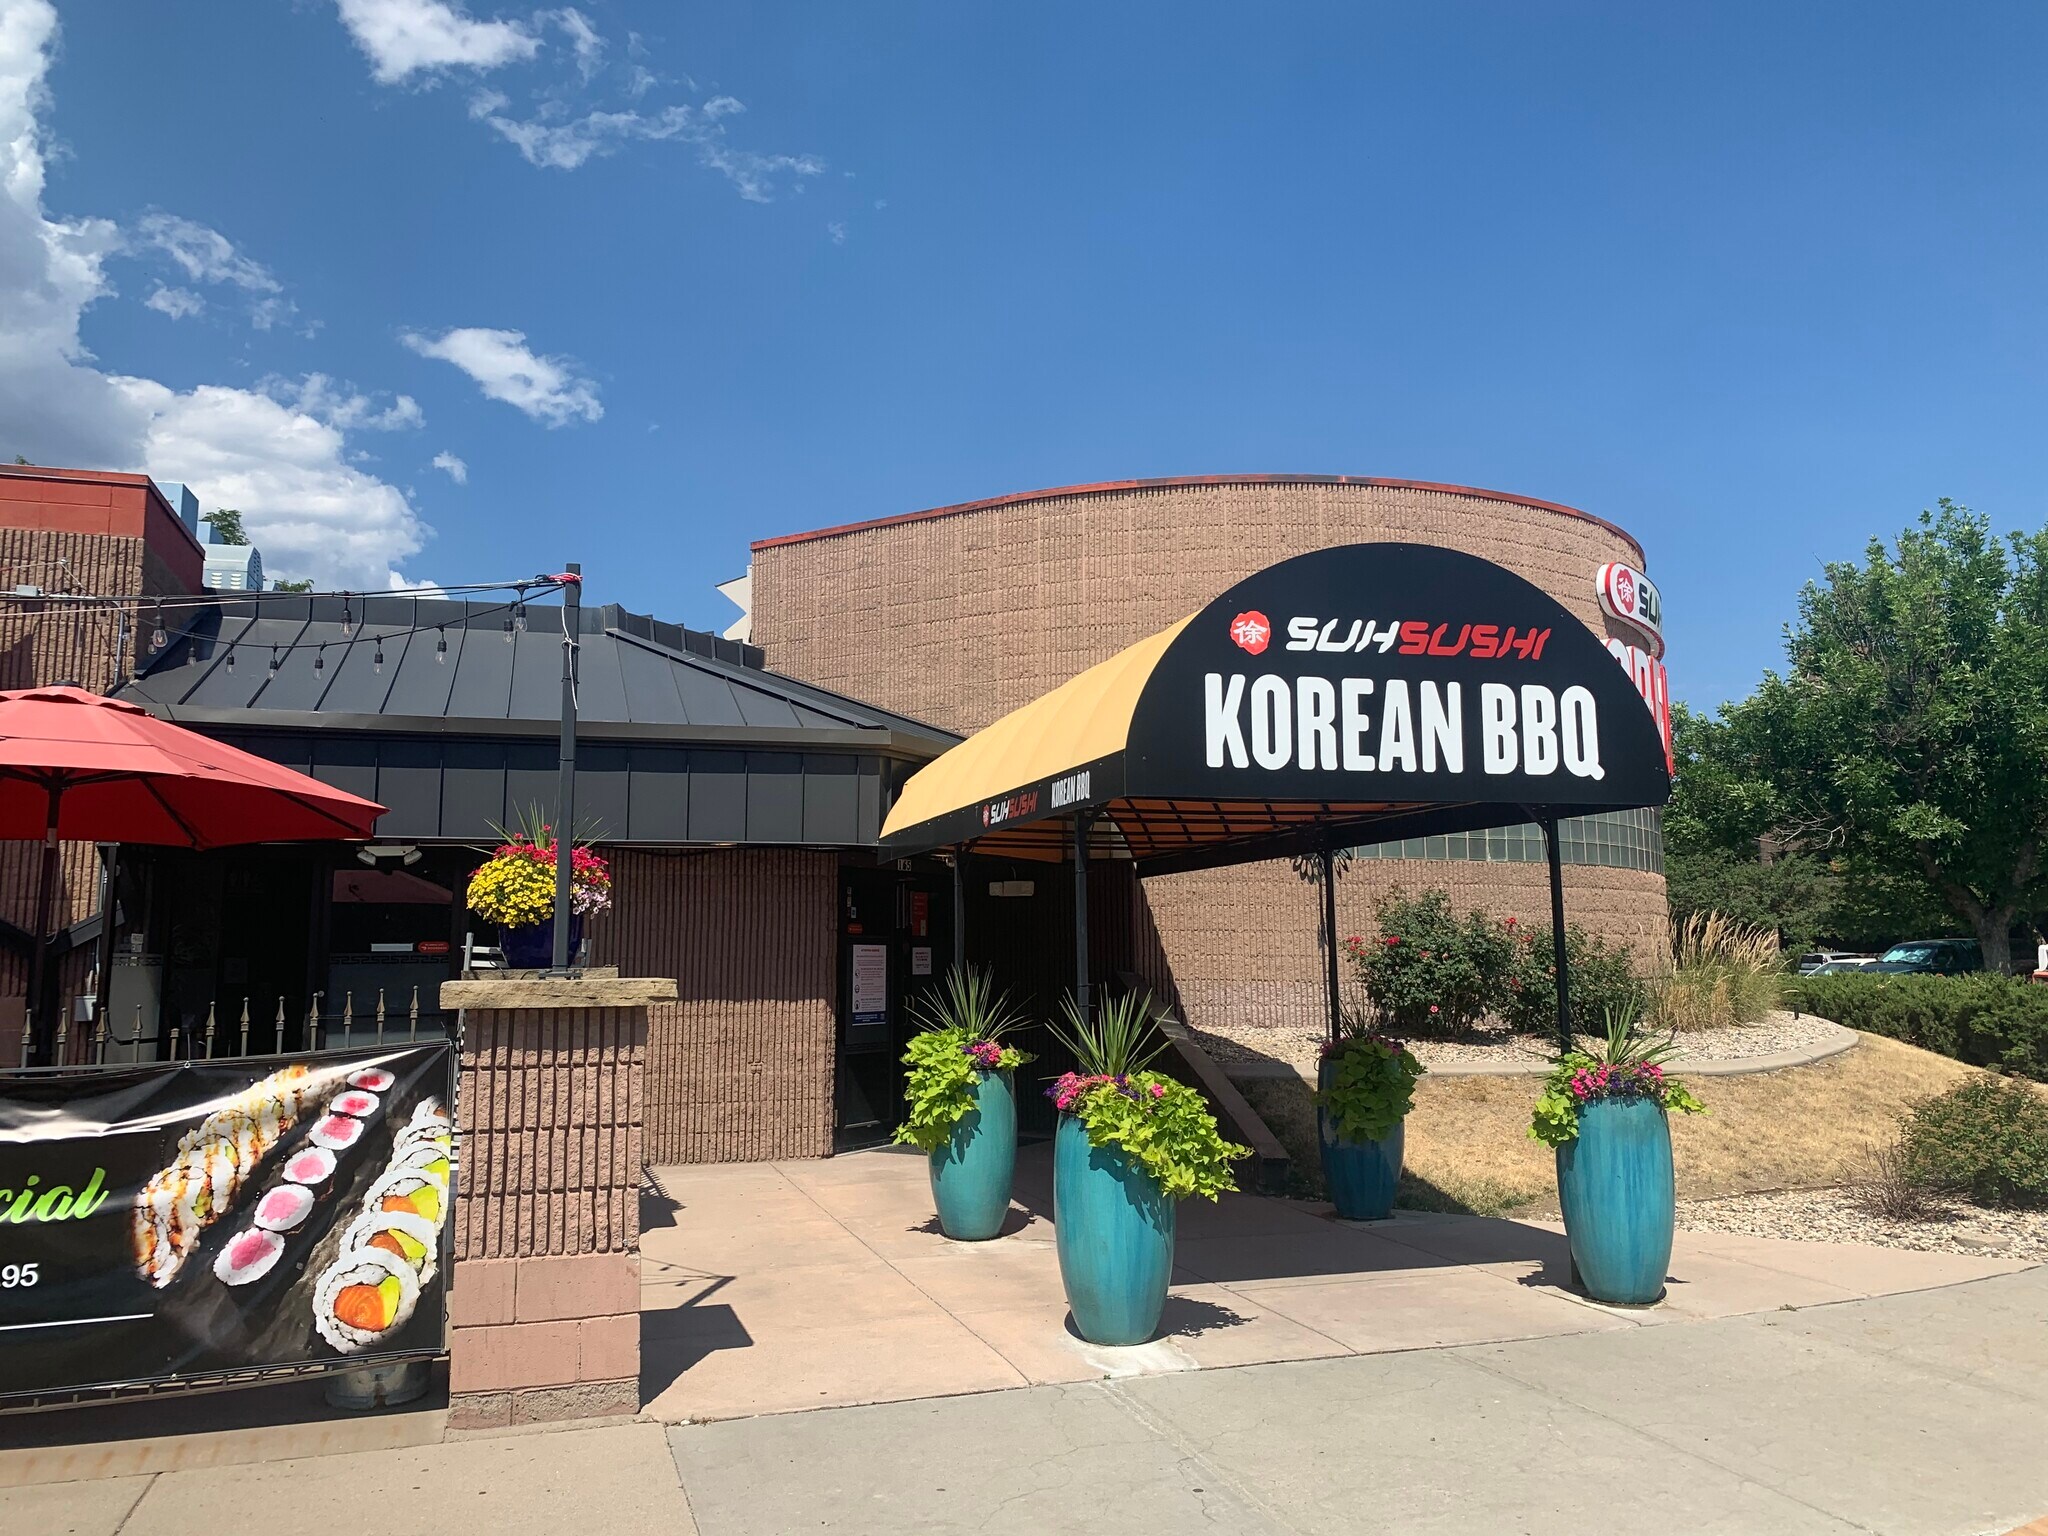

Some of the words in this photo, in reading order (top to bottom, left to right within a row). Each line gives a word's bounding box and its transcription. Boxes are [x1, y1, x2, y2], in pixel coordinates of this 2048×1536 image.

[1233, 620, 1267, 644] 徐
[1205, 673, 1463, 773] KOREAN
[1481, 683, 1605, 780] BBQ
[1051, 775, 1076, 809] KOREAN
[1076, 770, 1091, 801] BBQ
